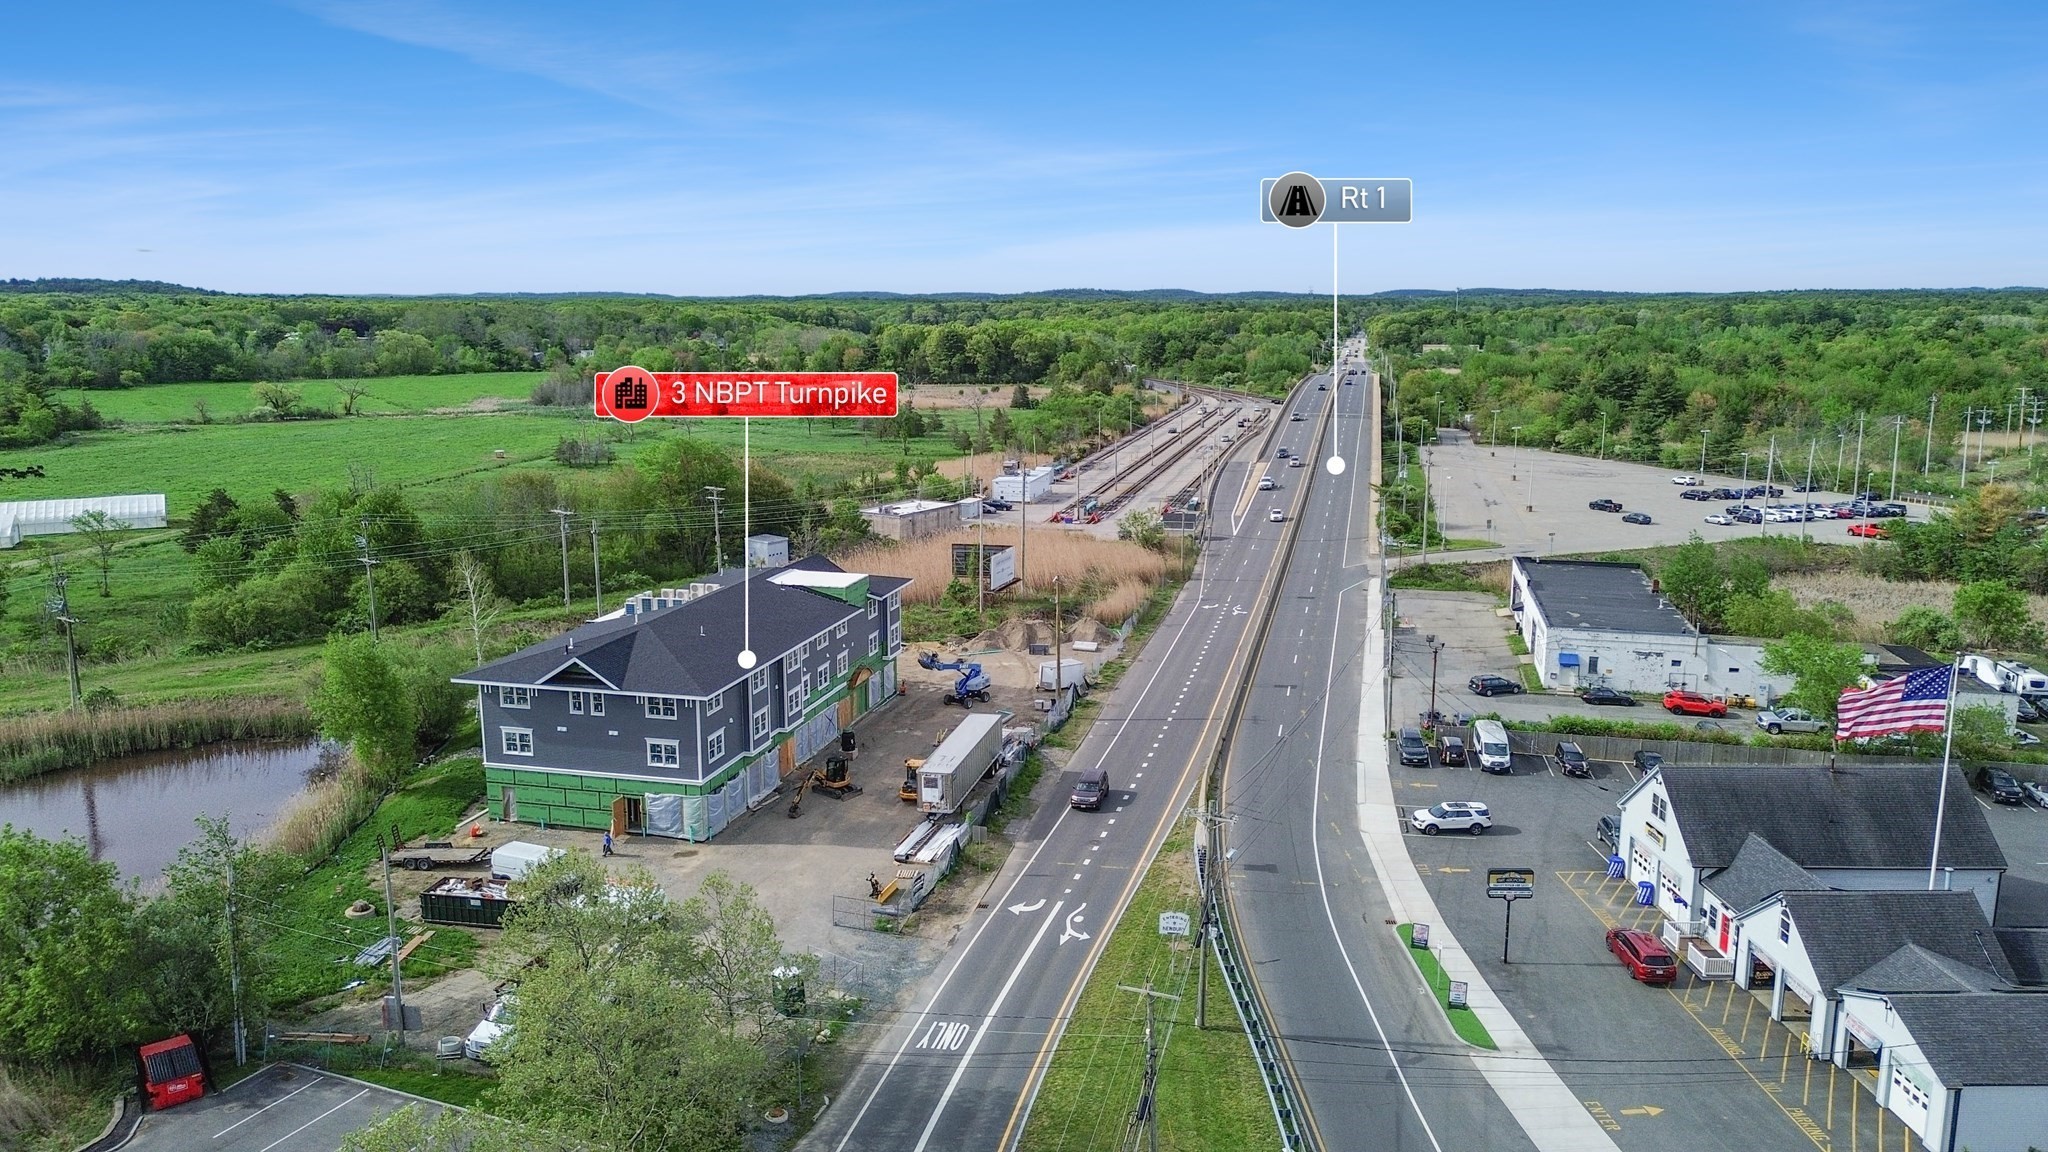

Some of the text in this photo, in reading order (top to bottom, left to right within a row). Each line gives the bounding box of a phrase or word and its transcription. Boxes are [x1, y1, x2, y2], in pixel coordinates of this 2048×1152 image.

[915, 1021, 970, 1051] ONLY
[1709, 1027, 1746, 1055] PARKING
[1584, 1101, 1621, 1131] ENTER
[1786, 1107, 1831, 1142] PARKING
